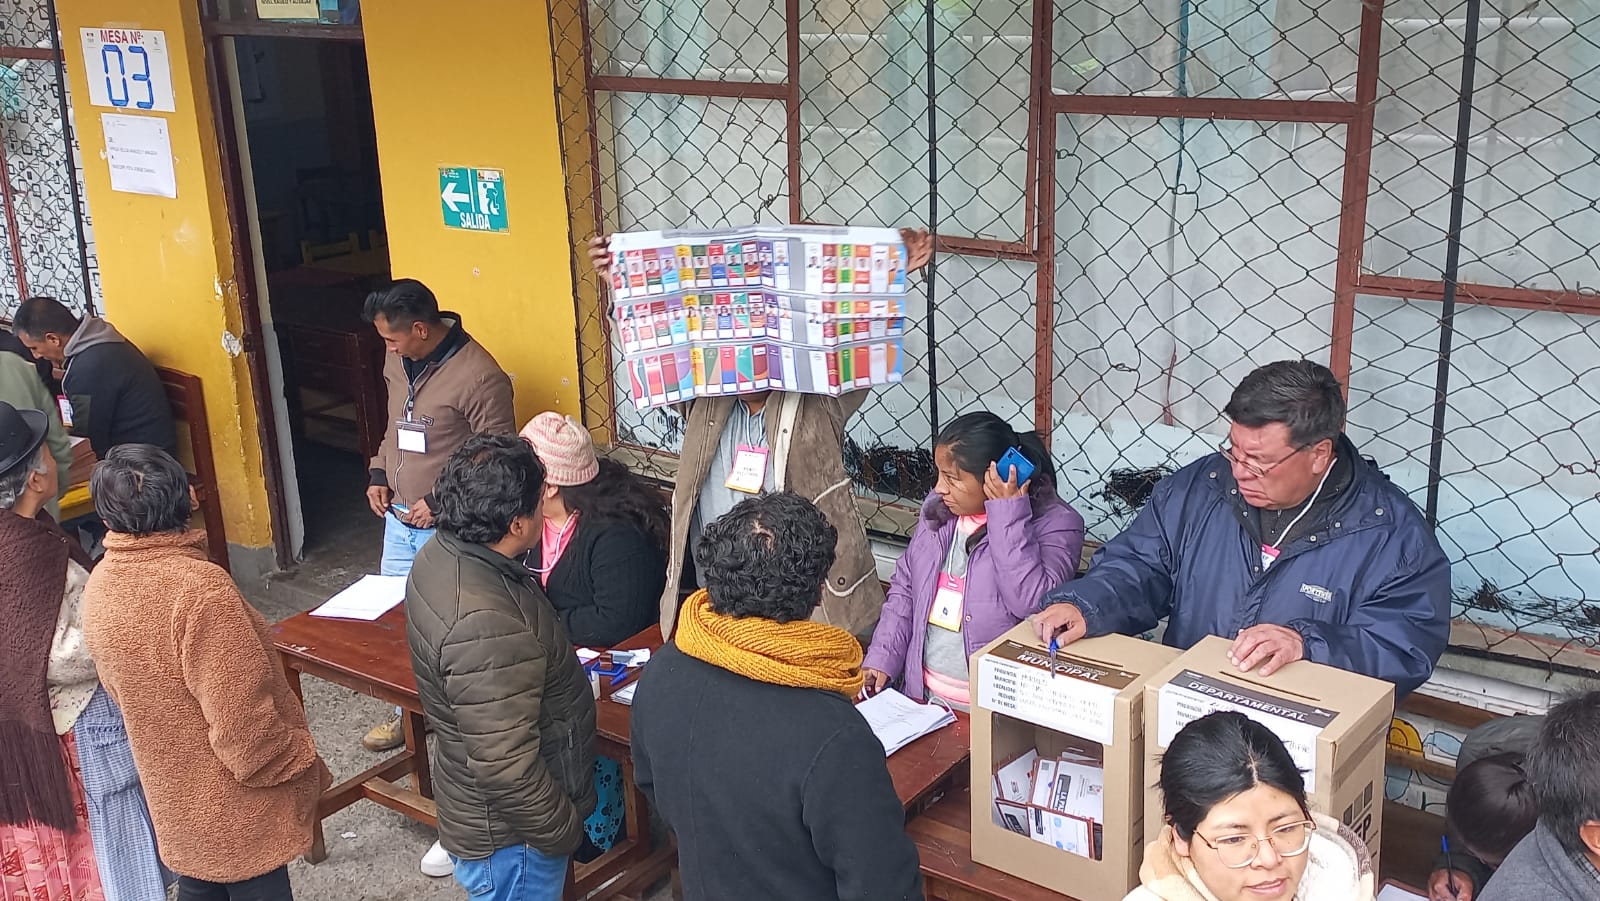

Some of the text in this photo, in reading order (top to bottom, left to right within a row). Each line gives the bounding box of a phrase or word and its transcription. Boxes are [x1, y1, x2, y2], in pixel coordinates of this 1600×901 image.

[100, 29, 129, 44] MESA
[101, 44, 154, 109] 03
[459, 212, 491, 230] SALIDA
[1017, 654, 1100, 681] MUNCIPAL
[1187, 681, 1308, 722] DEPARTAMENTAL
